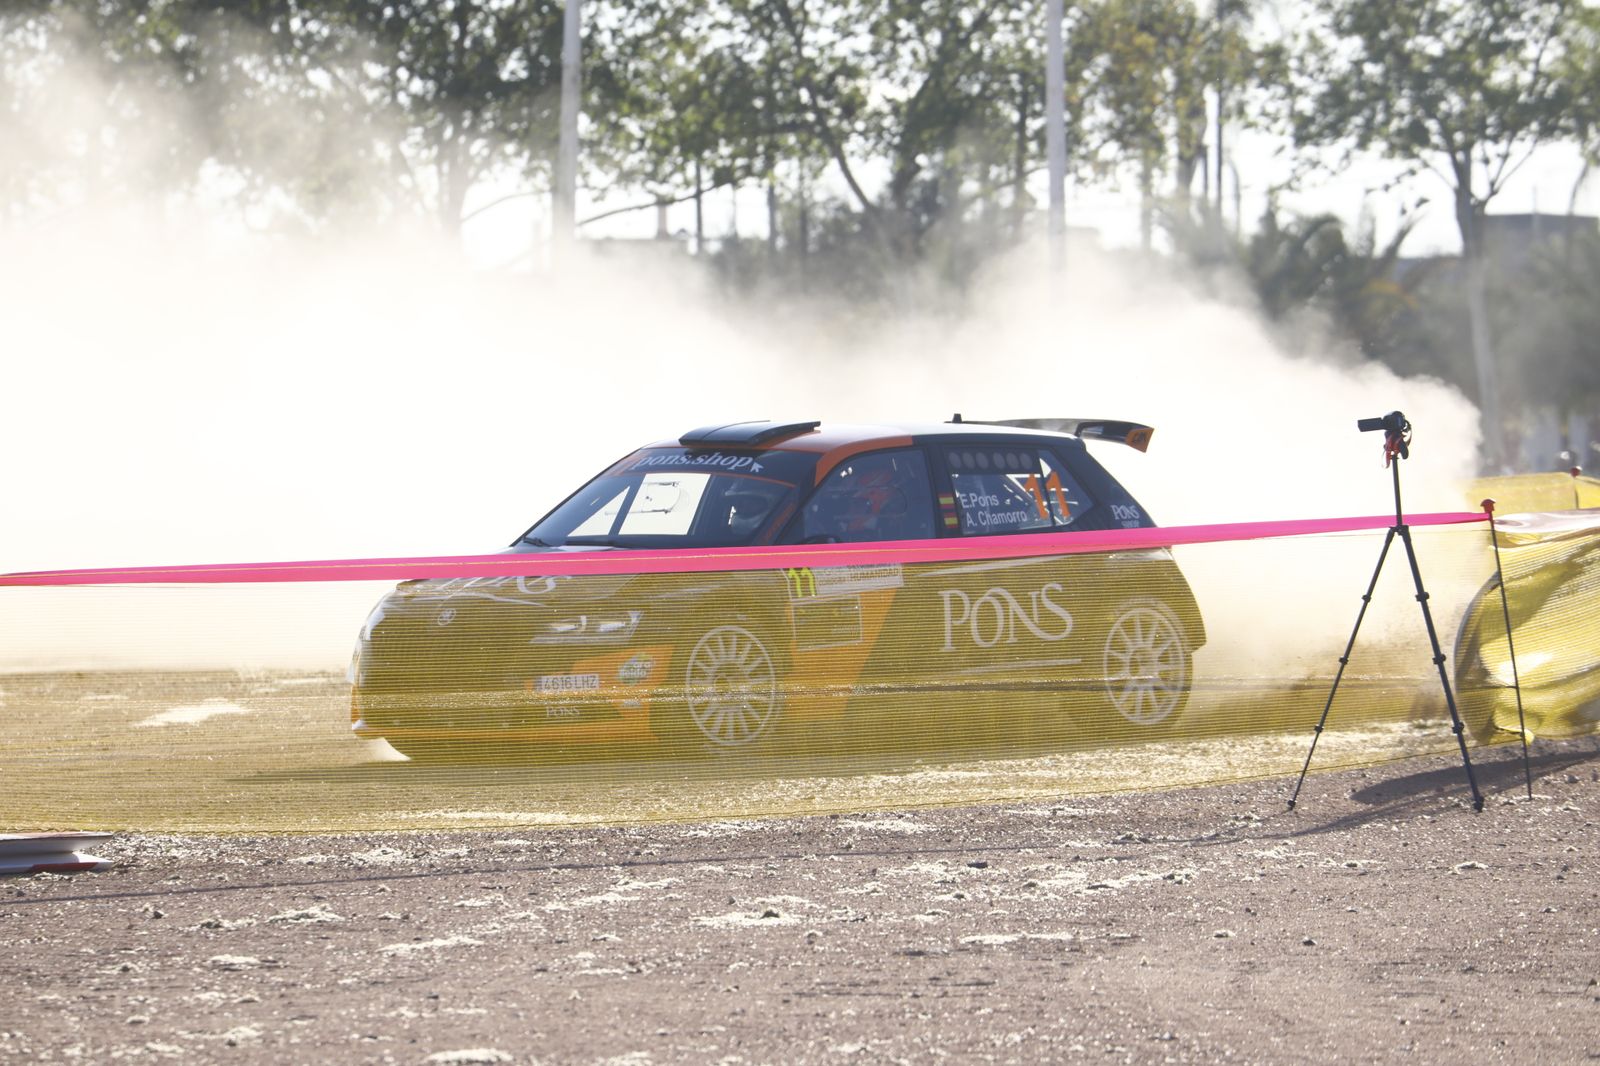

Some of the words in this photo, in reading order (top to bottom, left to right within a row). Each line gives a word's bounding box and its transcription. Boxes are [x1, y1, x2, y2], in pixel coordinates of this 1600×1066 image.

[629, 452, 753, 471] pons.shop
[959, 493, 999, 508] E.Pons
[1024, 470, 1071, 519] 11
[966, 511, 977, 527] A.
[978, 510, 1028, 526] Chamorro
[1110, 504, 1140, 520] PONS
[937, 582, 1073, 652] PONS
[544, 675, 572, 689] 4616
[574, 675, 598, 689] LHZ
